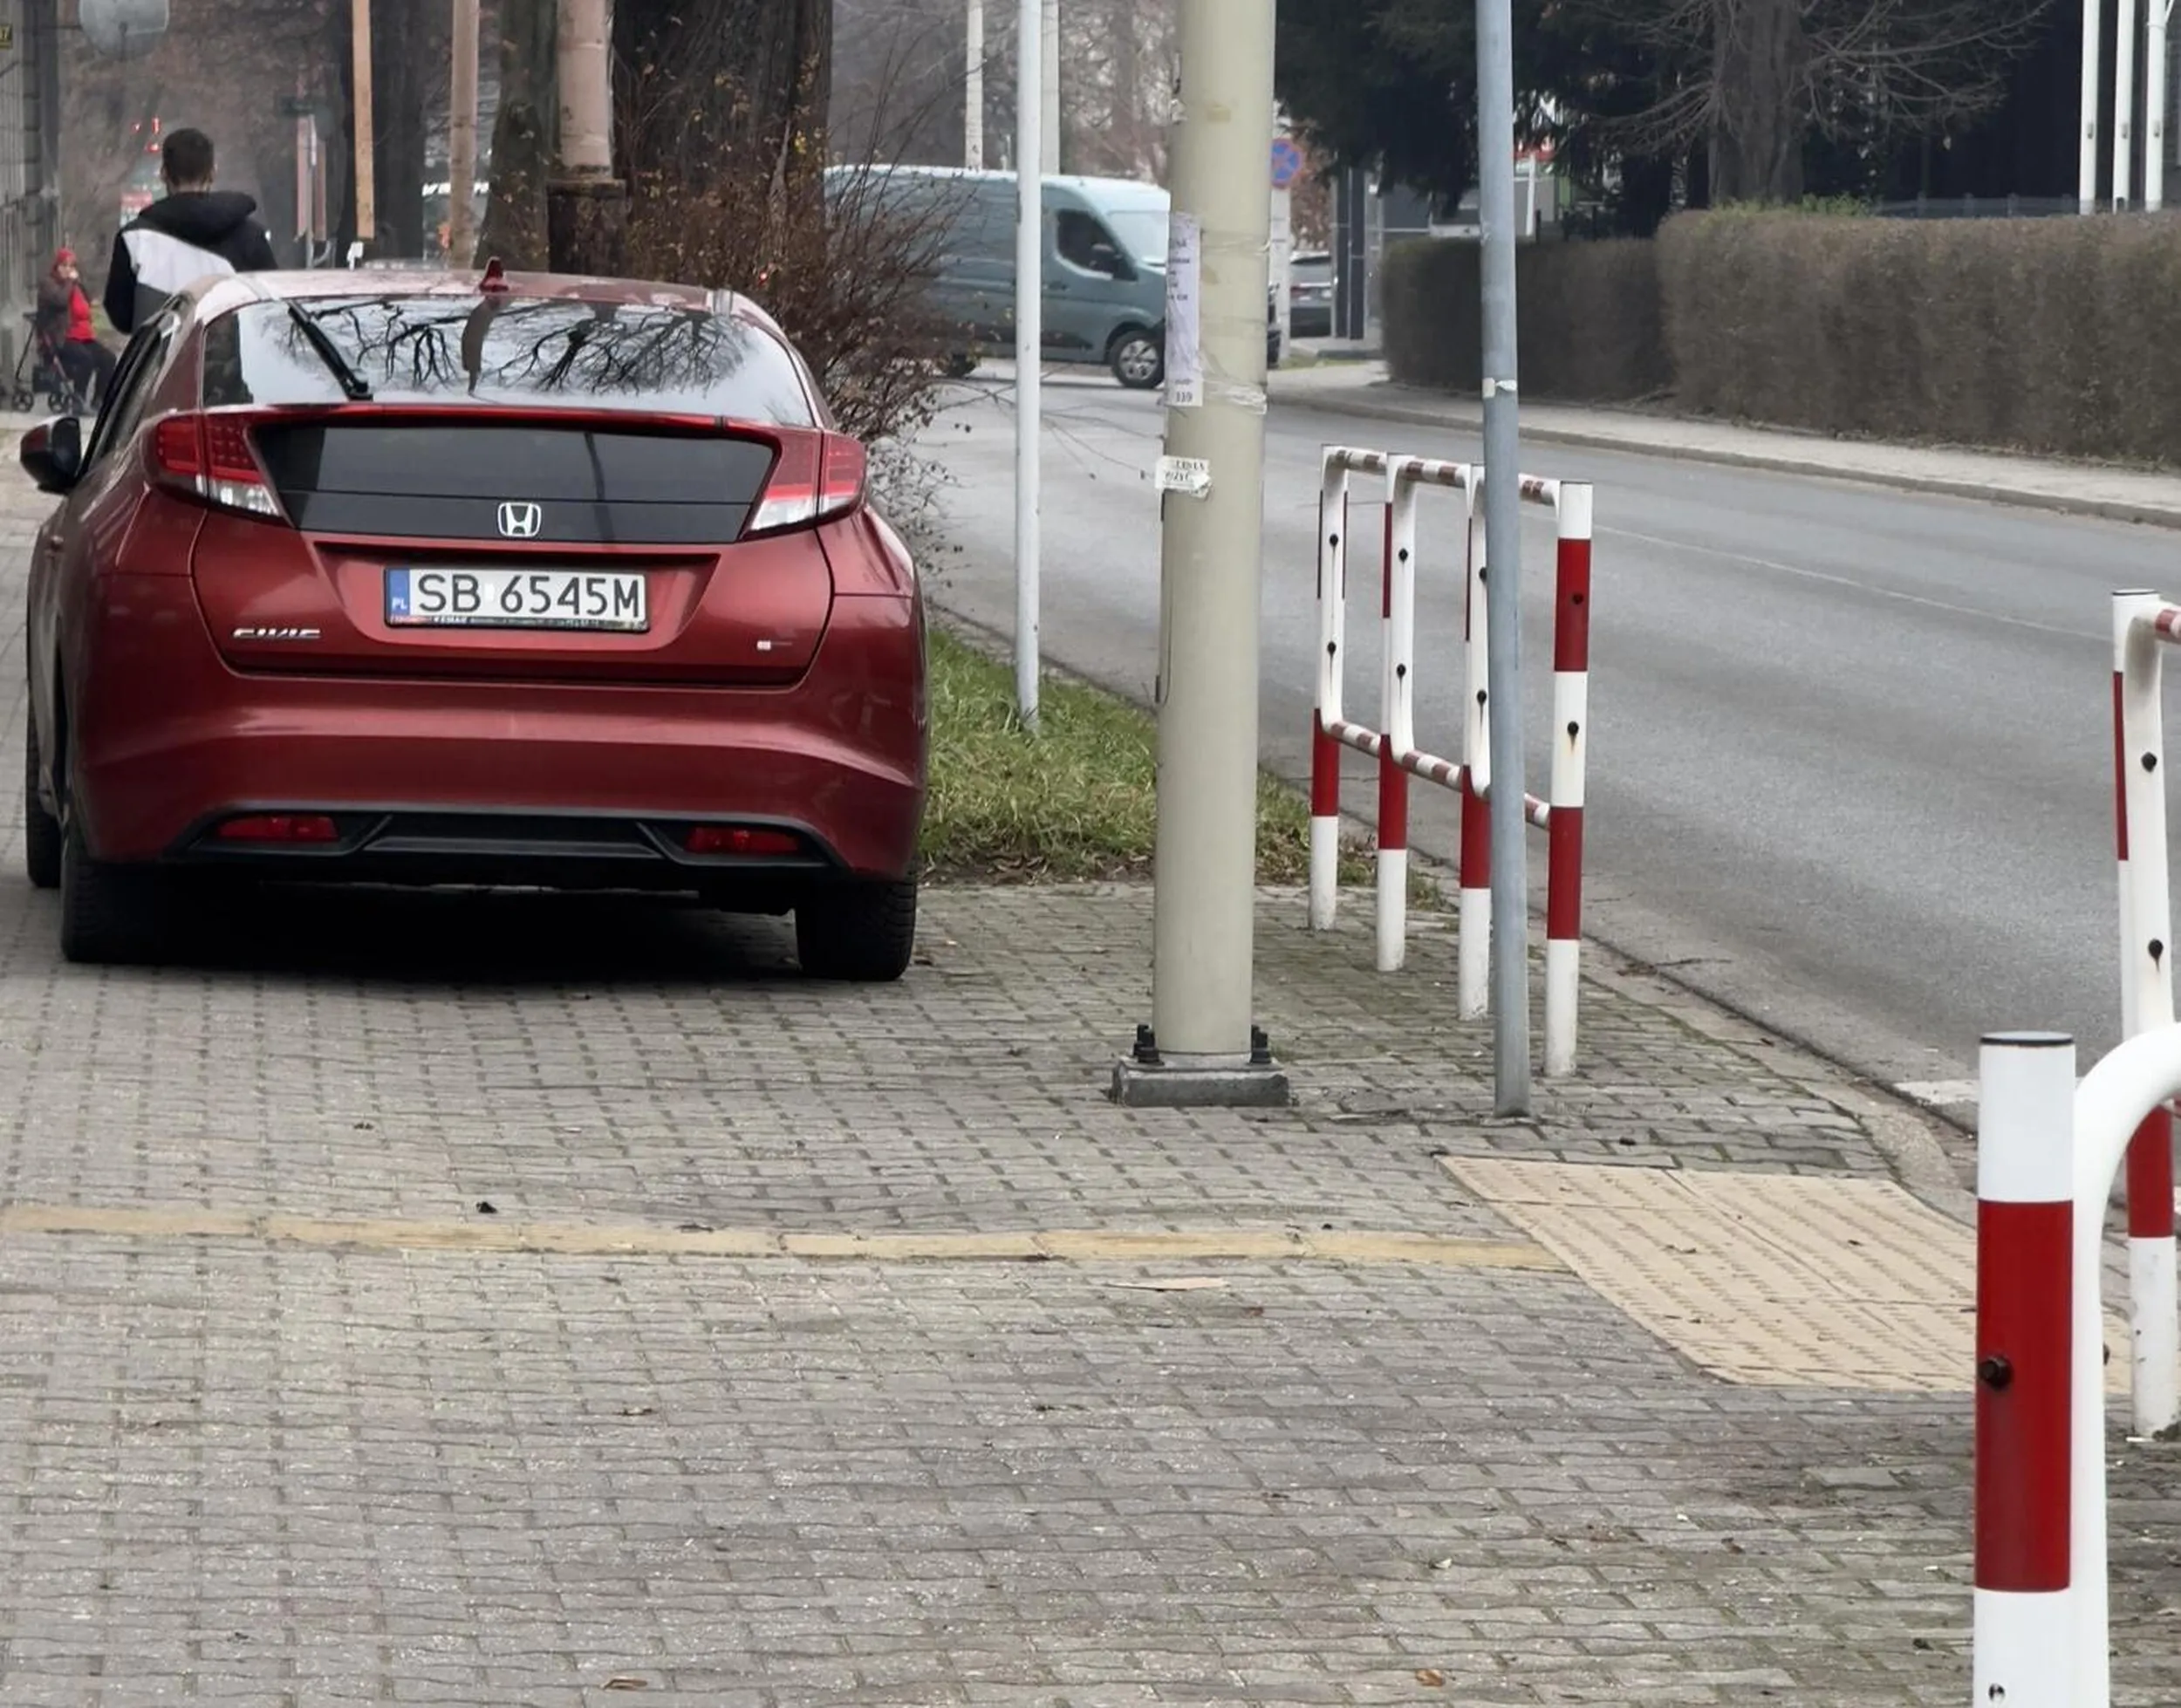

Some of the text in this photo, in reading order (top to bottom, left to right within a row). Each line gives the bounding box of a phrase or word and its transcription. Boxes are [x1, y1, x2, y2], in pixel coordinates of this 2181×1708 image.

[392, 598, 408, 610] PL
[418, 574, 639, 618] SB 6545M
